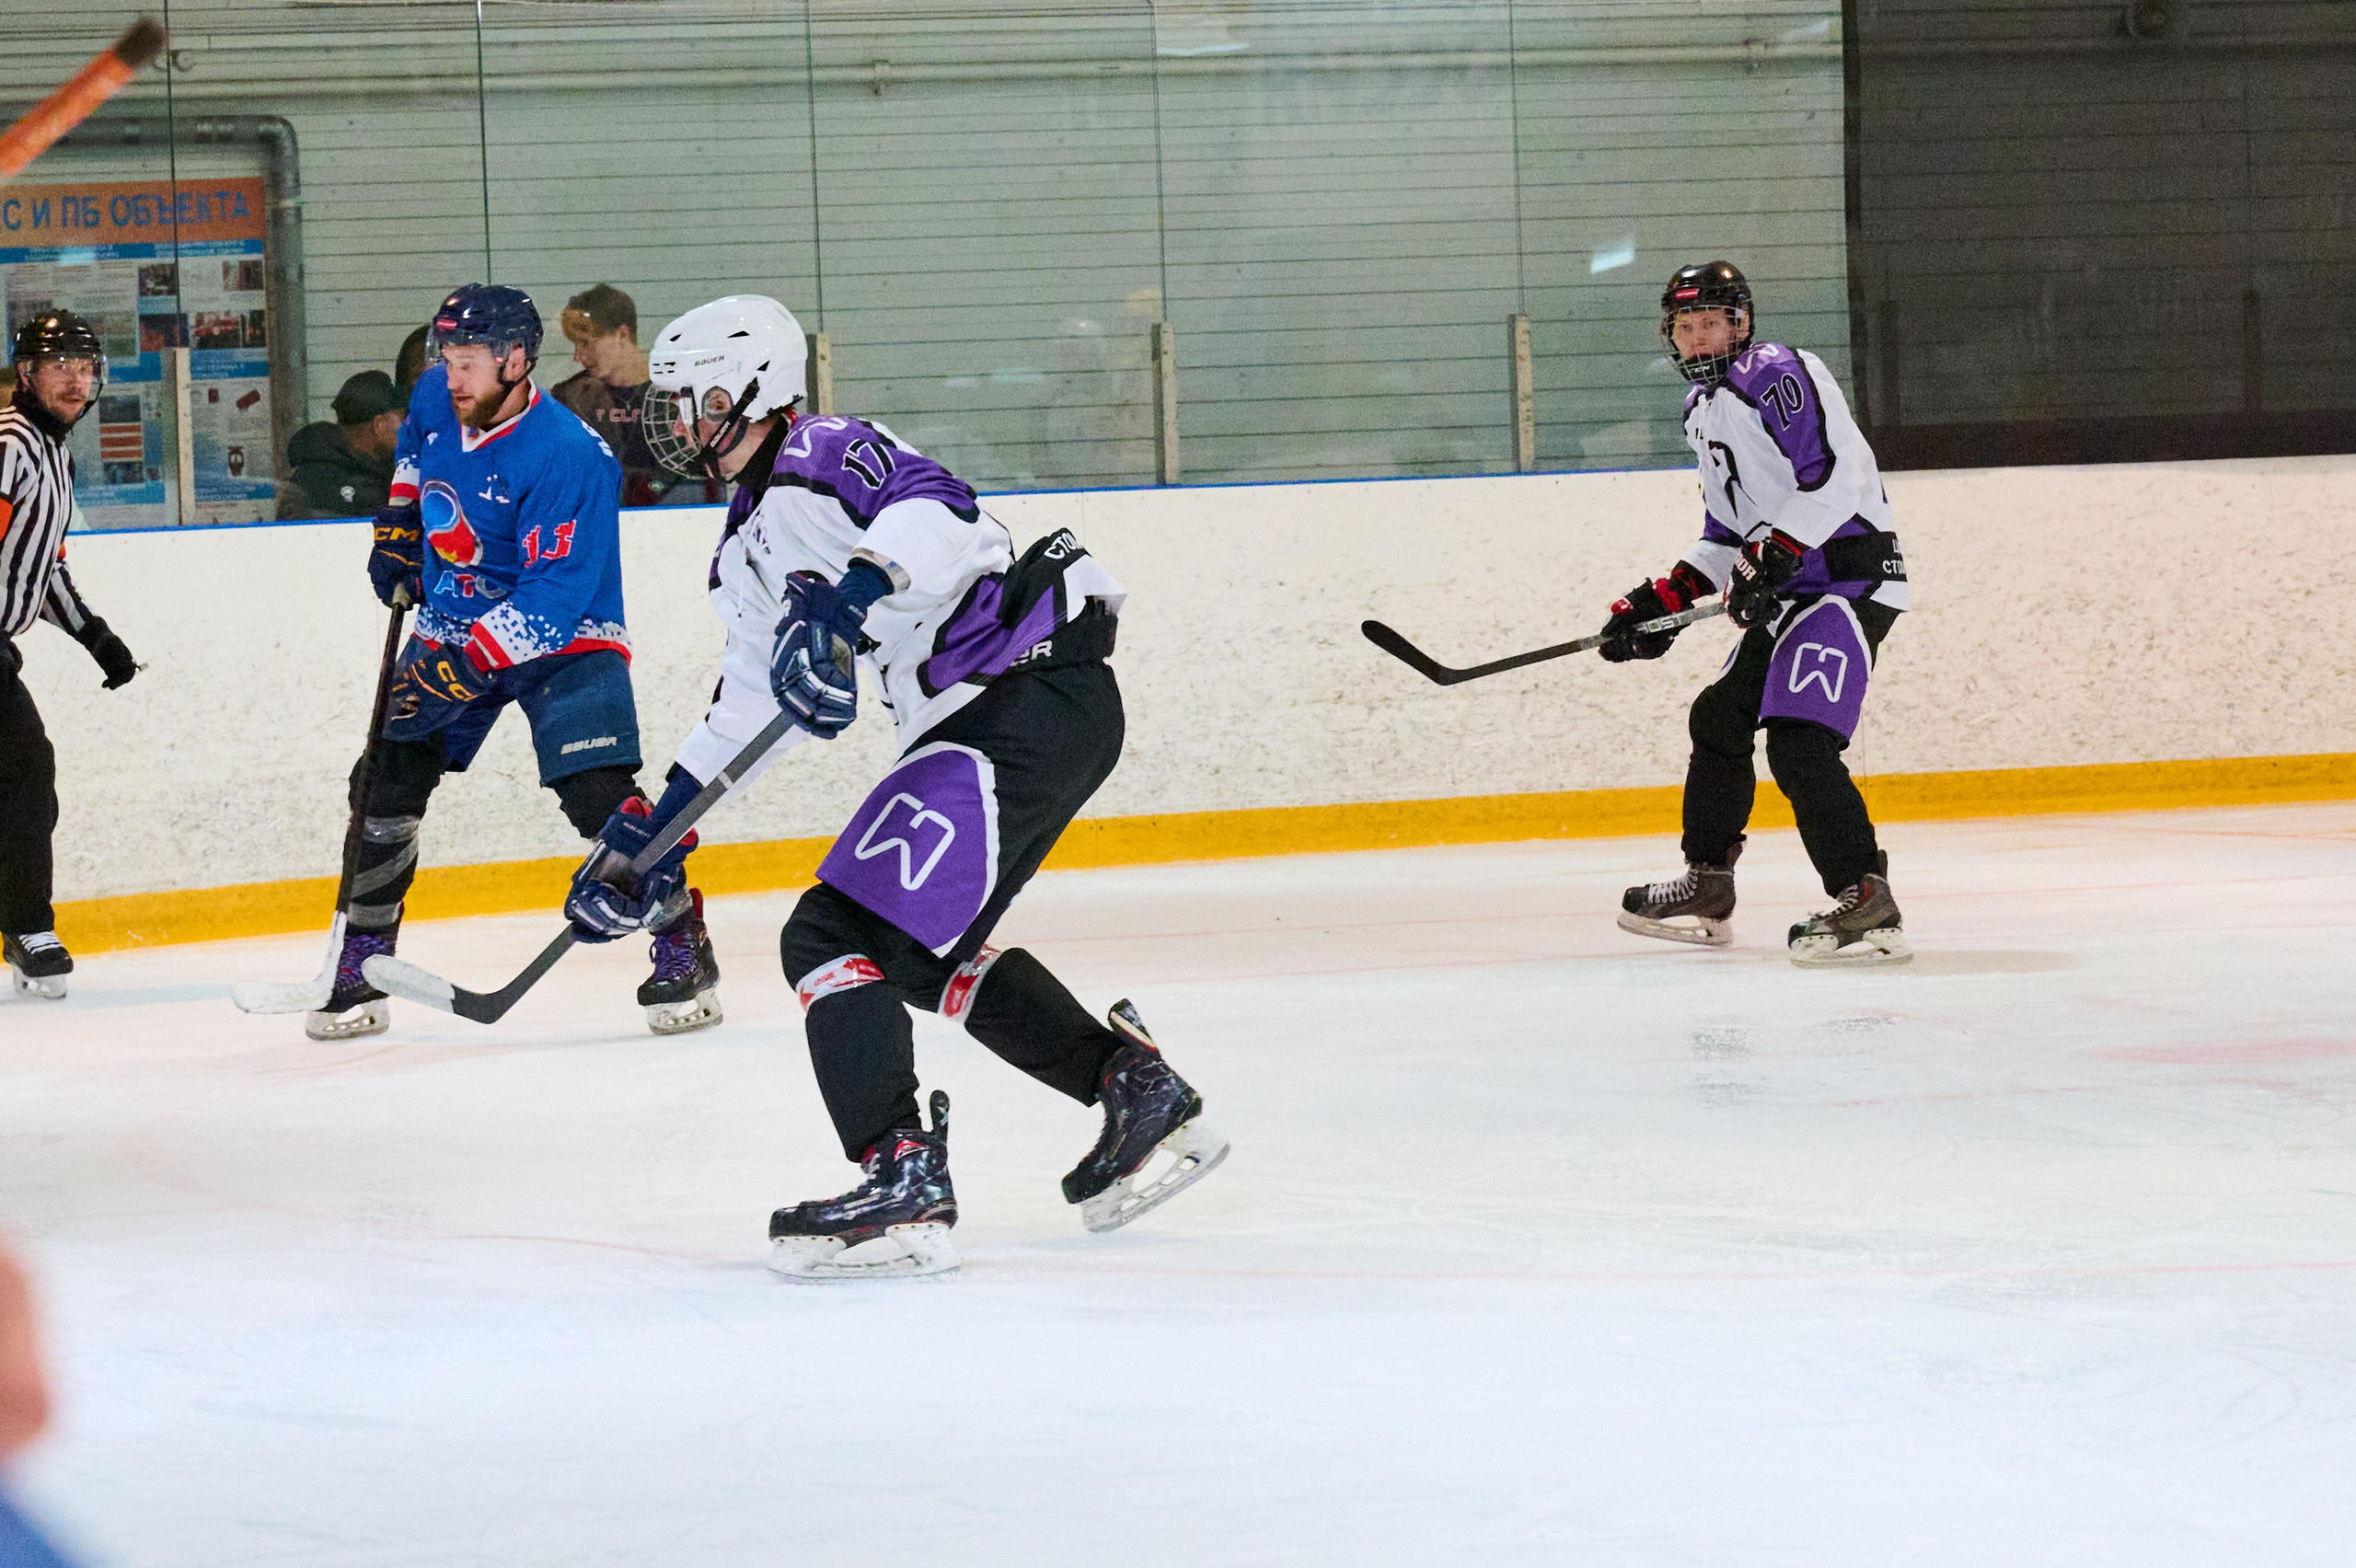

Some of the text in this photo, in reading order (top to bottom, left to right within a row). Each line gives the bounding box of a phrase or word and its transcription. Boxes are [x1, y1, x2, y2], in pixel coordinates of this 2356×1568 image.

[32, 197, 51, 229] И
[62, 195, 101, 228] ПБ
[110, 190, 249, 226] ОБЪЕКТА
[1760, 373, 1804, 432] 70
[841, 438, 896, 490] 17
